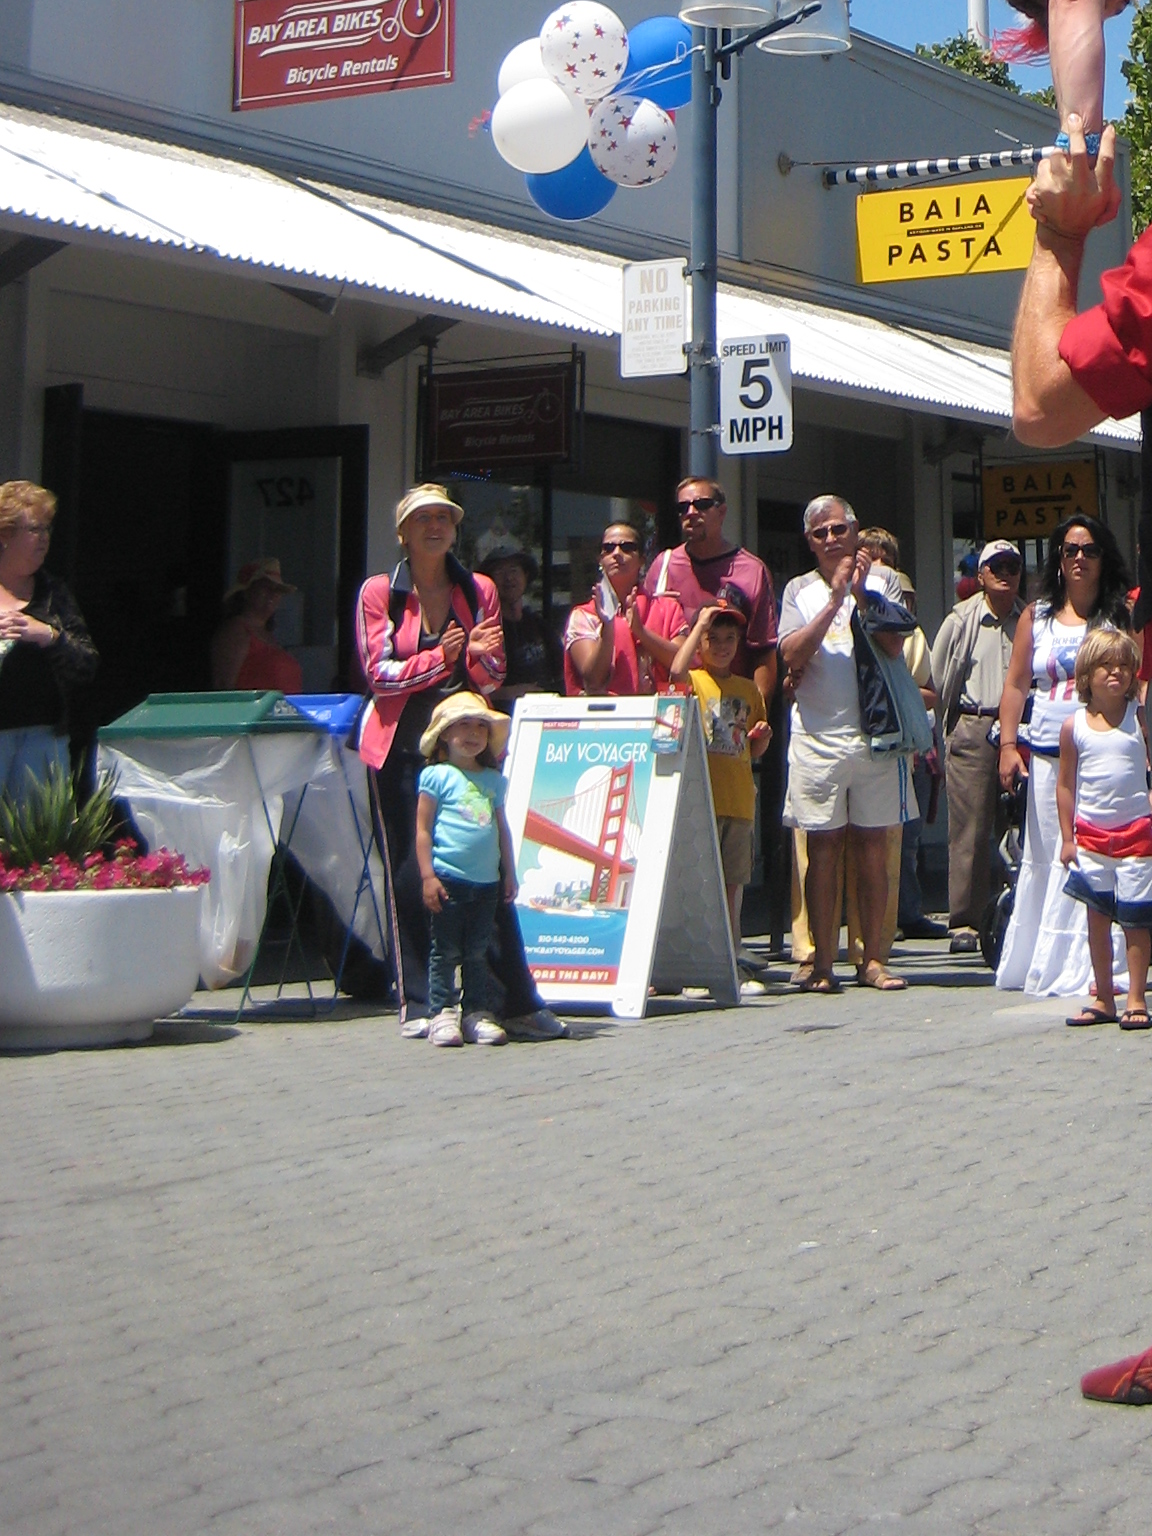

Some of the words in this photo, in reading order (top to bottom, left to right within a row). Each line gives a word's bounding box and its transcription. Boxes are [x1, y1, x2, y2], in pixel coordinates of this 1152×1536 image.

[248, 24, 283, 45] BAY
[282, 16, 328, 40] AREA
[332, 9, 383, 34] BIKES
[286, 63, 338, 86] Bicycle
[340, 54, 399, 76] Rentals
[900, 194, 991, 223] BAIA
[888, 236, 1002, 265] PASTA
[640, 268, 668, 294] NO
[629, 296, 680, 314] PARKING
[627, 317, 649, 332] ANY
[654, 315, 682, 330] TIME
[723, 344, 756, 357] SPEED
[760, 341, 788, 353] LIMIT
[739, 358, 772, 409] 5
[440, 408, 461, 421] BAY
[463, 406, 490, 418] AREA
[494, 403, 526, 416] BIKES
[730, 415, 783, 443] MPH
[465, 435, 497, 448] Bicycle
[1003, 472, 1076, 492] BAIA
[545, 743, 573, 763] BAY
[577, 742, 648, 763] VOYAGER
[531, 969, 556, 980] ORE
[559, 970, 579, 980] THE
[581, 971, 609, 981] BAY!
